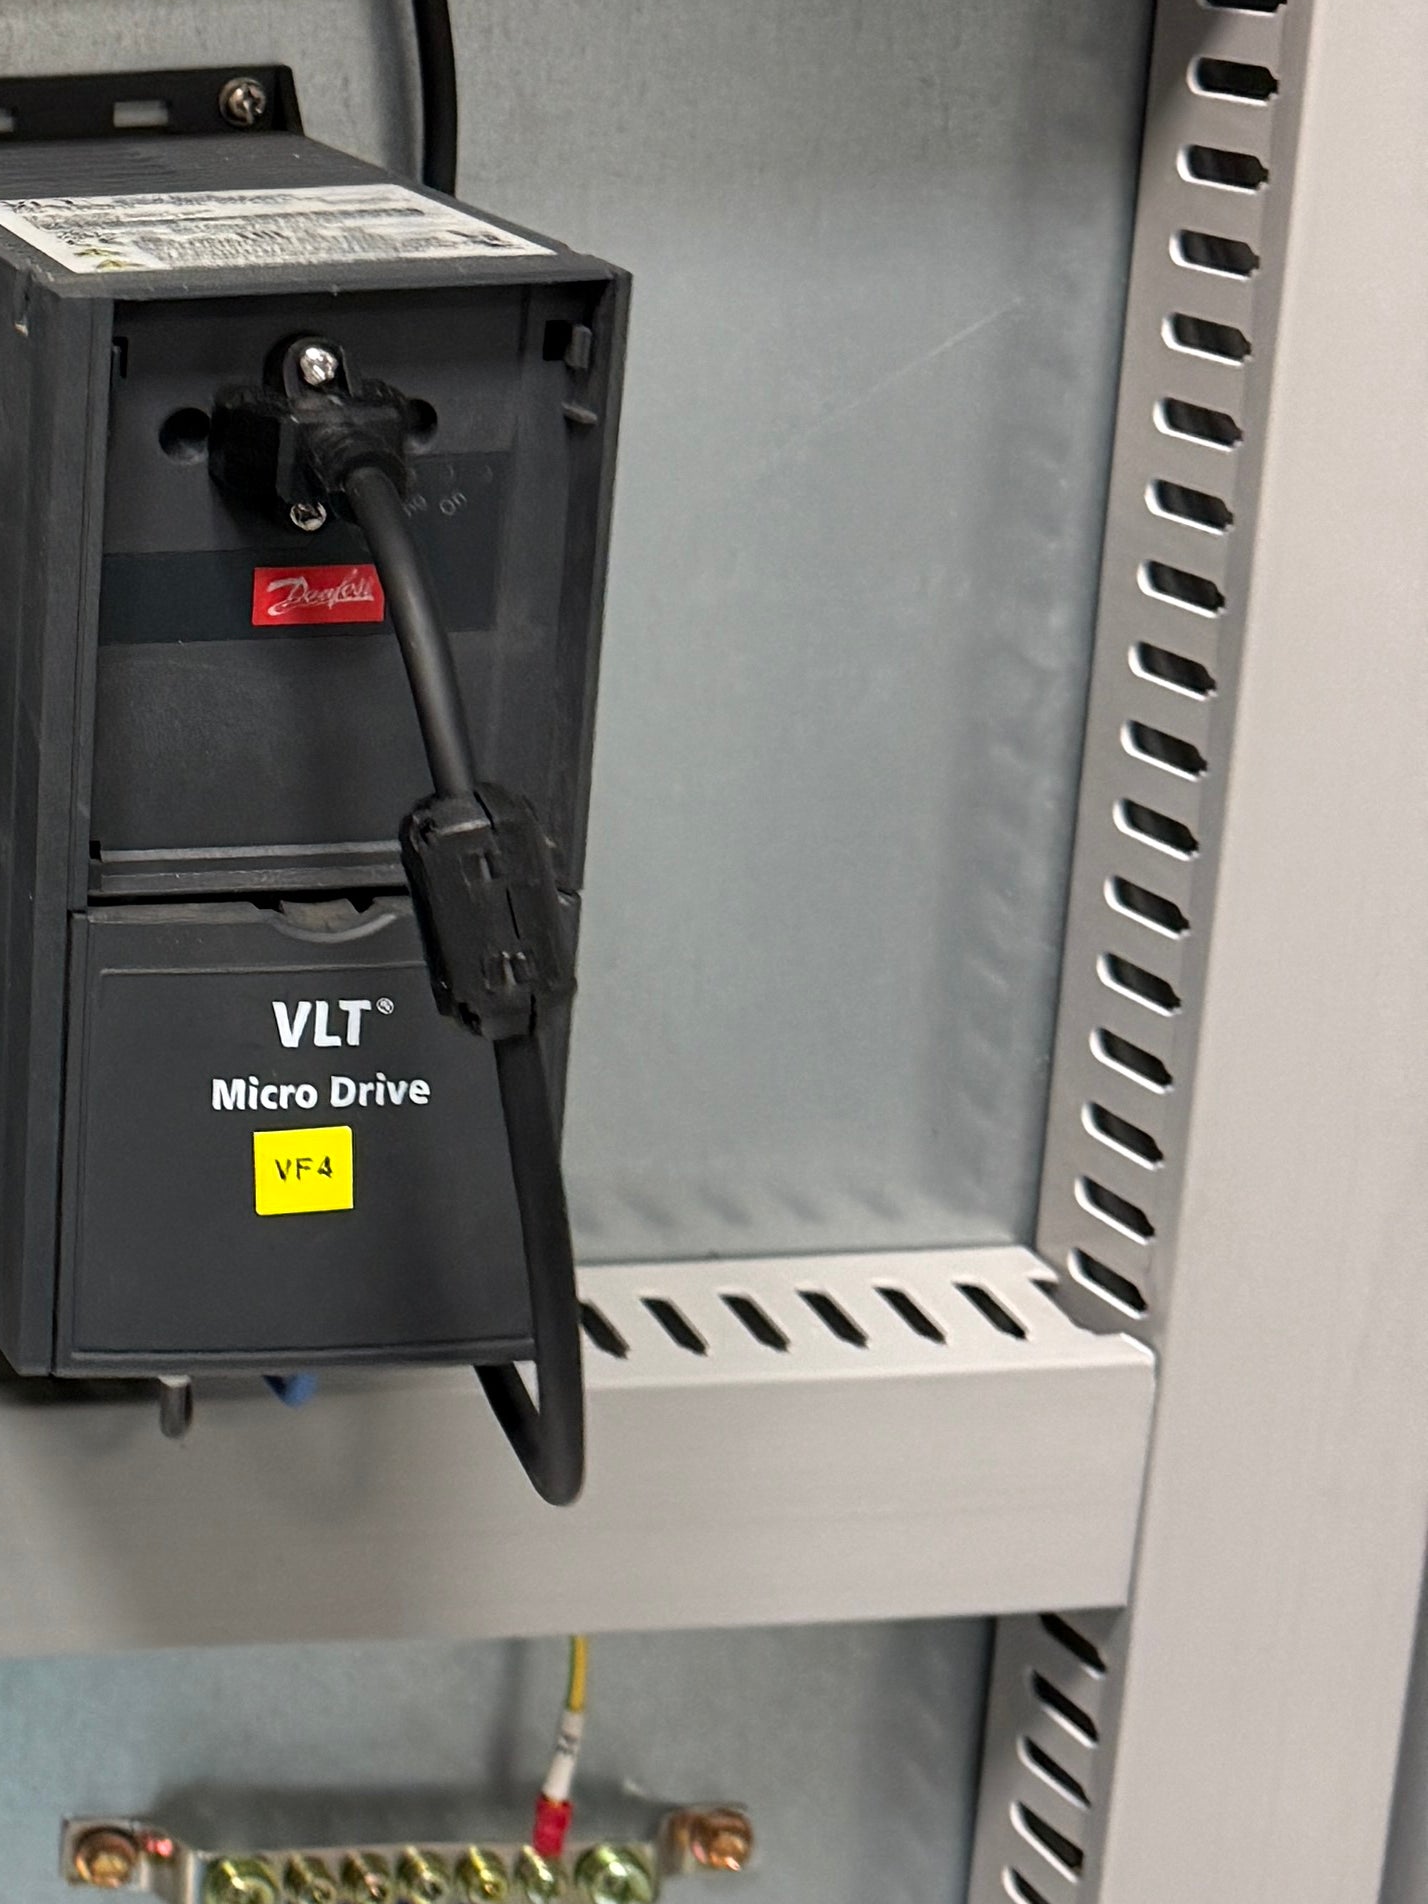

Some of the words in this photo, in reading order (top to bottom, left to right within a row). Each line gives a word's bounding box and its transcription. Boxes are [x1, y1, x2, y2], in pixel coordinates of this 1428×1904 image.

[267, 569, 375, 617] Danfoss
[211, 1075, 319, 1111] Micro
[329, 1072, 432, 1109] Drive
[274, 1155, 334, 1182] VF4
